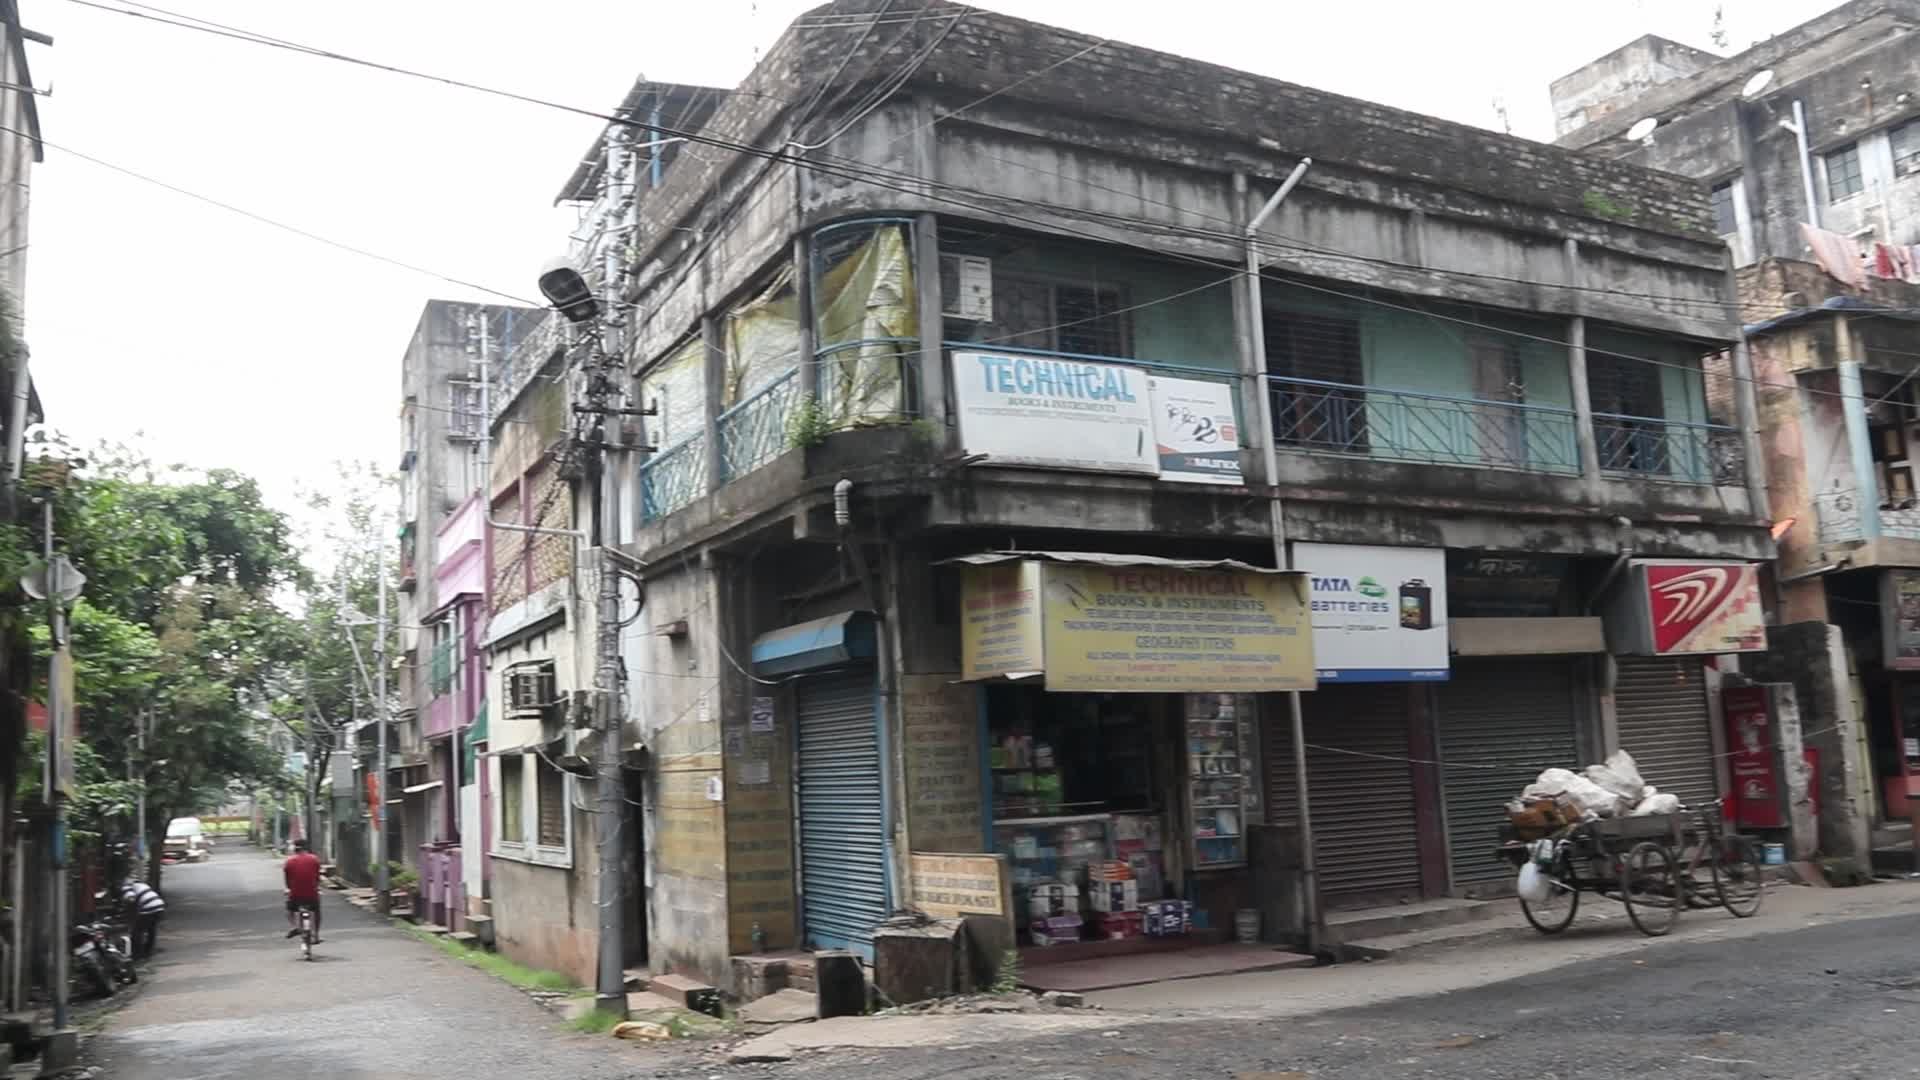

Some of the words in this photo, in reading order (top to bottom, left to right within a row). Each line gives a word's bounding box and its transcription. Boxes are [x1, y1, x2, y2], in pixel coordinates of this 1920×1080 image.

[978, 356, 1137, 402] TECHNICAL
[1008, 398, 1041, 408] BOOKS
[1109, 571, 1250, 596] TECHNICAL
[1312, 577, 1352, 592] TATA
[1096, 593, 1146, 608] BOOKS
[1151, 596, 1163, 608] &
[1167, 596, 1265, 611] INSTRUMENTS
